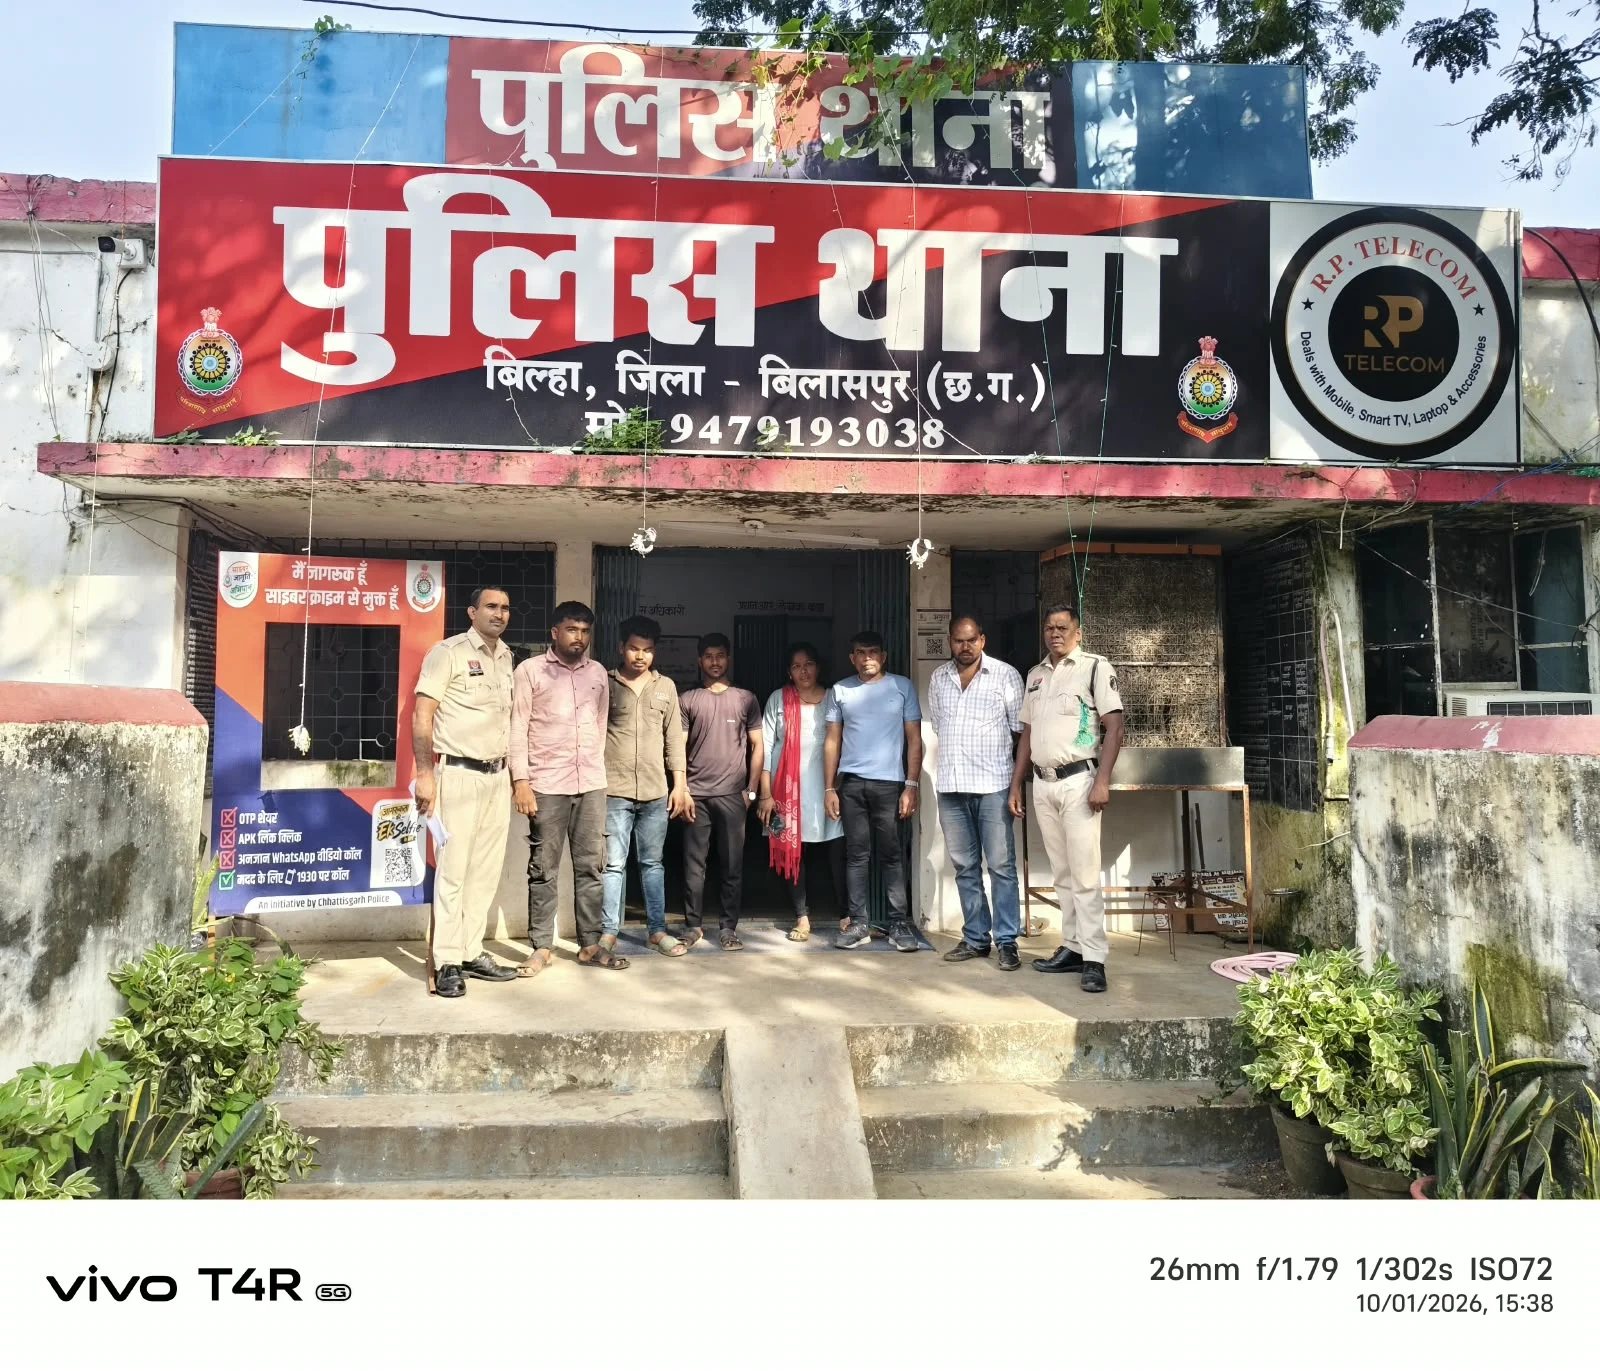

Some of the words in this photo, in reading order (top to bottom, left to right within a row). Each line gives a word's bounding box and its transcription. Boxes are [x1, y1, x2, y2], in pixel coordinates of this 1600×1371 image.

[471, 43, 781, 169] पुलिस
[819, 85, 1052, 169] थाना
[273, 172, 775, 386] पुलिस
[817, 227, 1179, 357] थाना
[1310, 254, 1353, 294] R.P.
[1353, 236, 1478, 300] TELECOM
[1363, 295, 1424, 348] RP
[1344, 354, 1445, 373] TELECOM
[483, 345, 596, 401] बिल्हा,
[615, 350, 706, 396] जिला
[758, 354, 911, 413] बिलासपुर
[927, 361, 1045, 412] (छ.ग.)
[1300, 331, 1315, 363] Deals
[1309, 363, 1326, 388] with
[1323, 384, 1356, 418] Mobile,
[1358, 408, 1391, 426] Smart
[1393, 414, 1411, 428] TV,
[1413, 403, 1449, 425] Laptop
[1448, 394, 1458, 406] &
[1455, 335, 1487, 399] Accessories
[670, 413, 945, 448] 9479193038
[292, 560, 307, 580] मैं
[307, 564, 355, 582] जागरूक
[357, 560, 369, 586] हूँ
[265, 588, 307, 605] साइबर
[308, 589, 344, 606] क्राइम
[347, 587, 360, 606] से
[362, 590, 388, 611] मुक्त
[389, 584, 400, 610] हूँ
[239, 812, 256, 824] OTP
[257, 810, 278, 825] शेयर
[238, 832, 256, 844] APK
[257, 829, 277, 844] लिंक
[278, 829, 302, 844] क्लिक
[238, 852, 270, 866] अनजान
[272, 850, 315, 864] WhatsApp
[317, 847, 343, 862] वीडियो
[344, 846, 362, 861] कॉल
[237, 873, 256, 886] मदद
[257, 870, 266, 884] के
[267, 870, 284, 884] लिए
[297, 870, 317, 882] 1930
[318, 869, 330, 882] पर
[331, 866, 350, 881] कॉल
[258, 901, 269, 910] An
[270, 900, 305, 909] initiative
[306, 899, 317, 908] by
[318, 896, 366, 907] Chhattisgarh
[367, 894, 390, 904] Police
